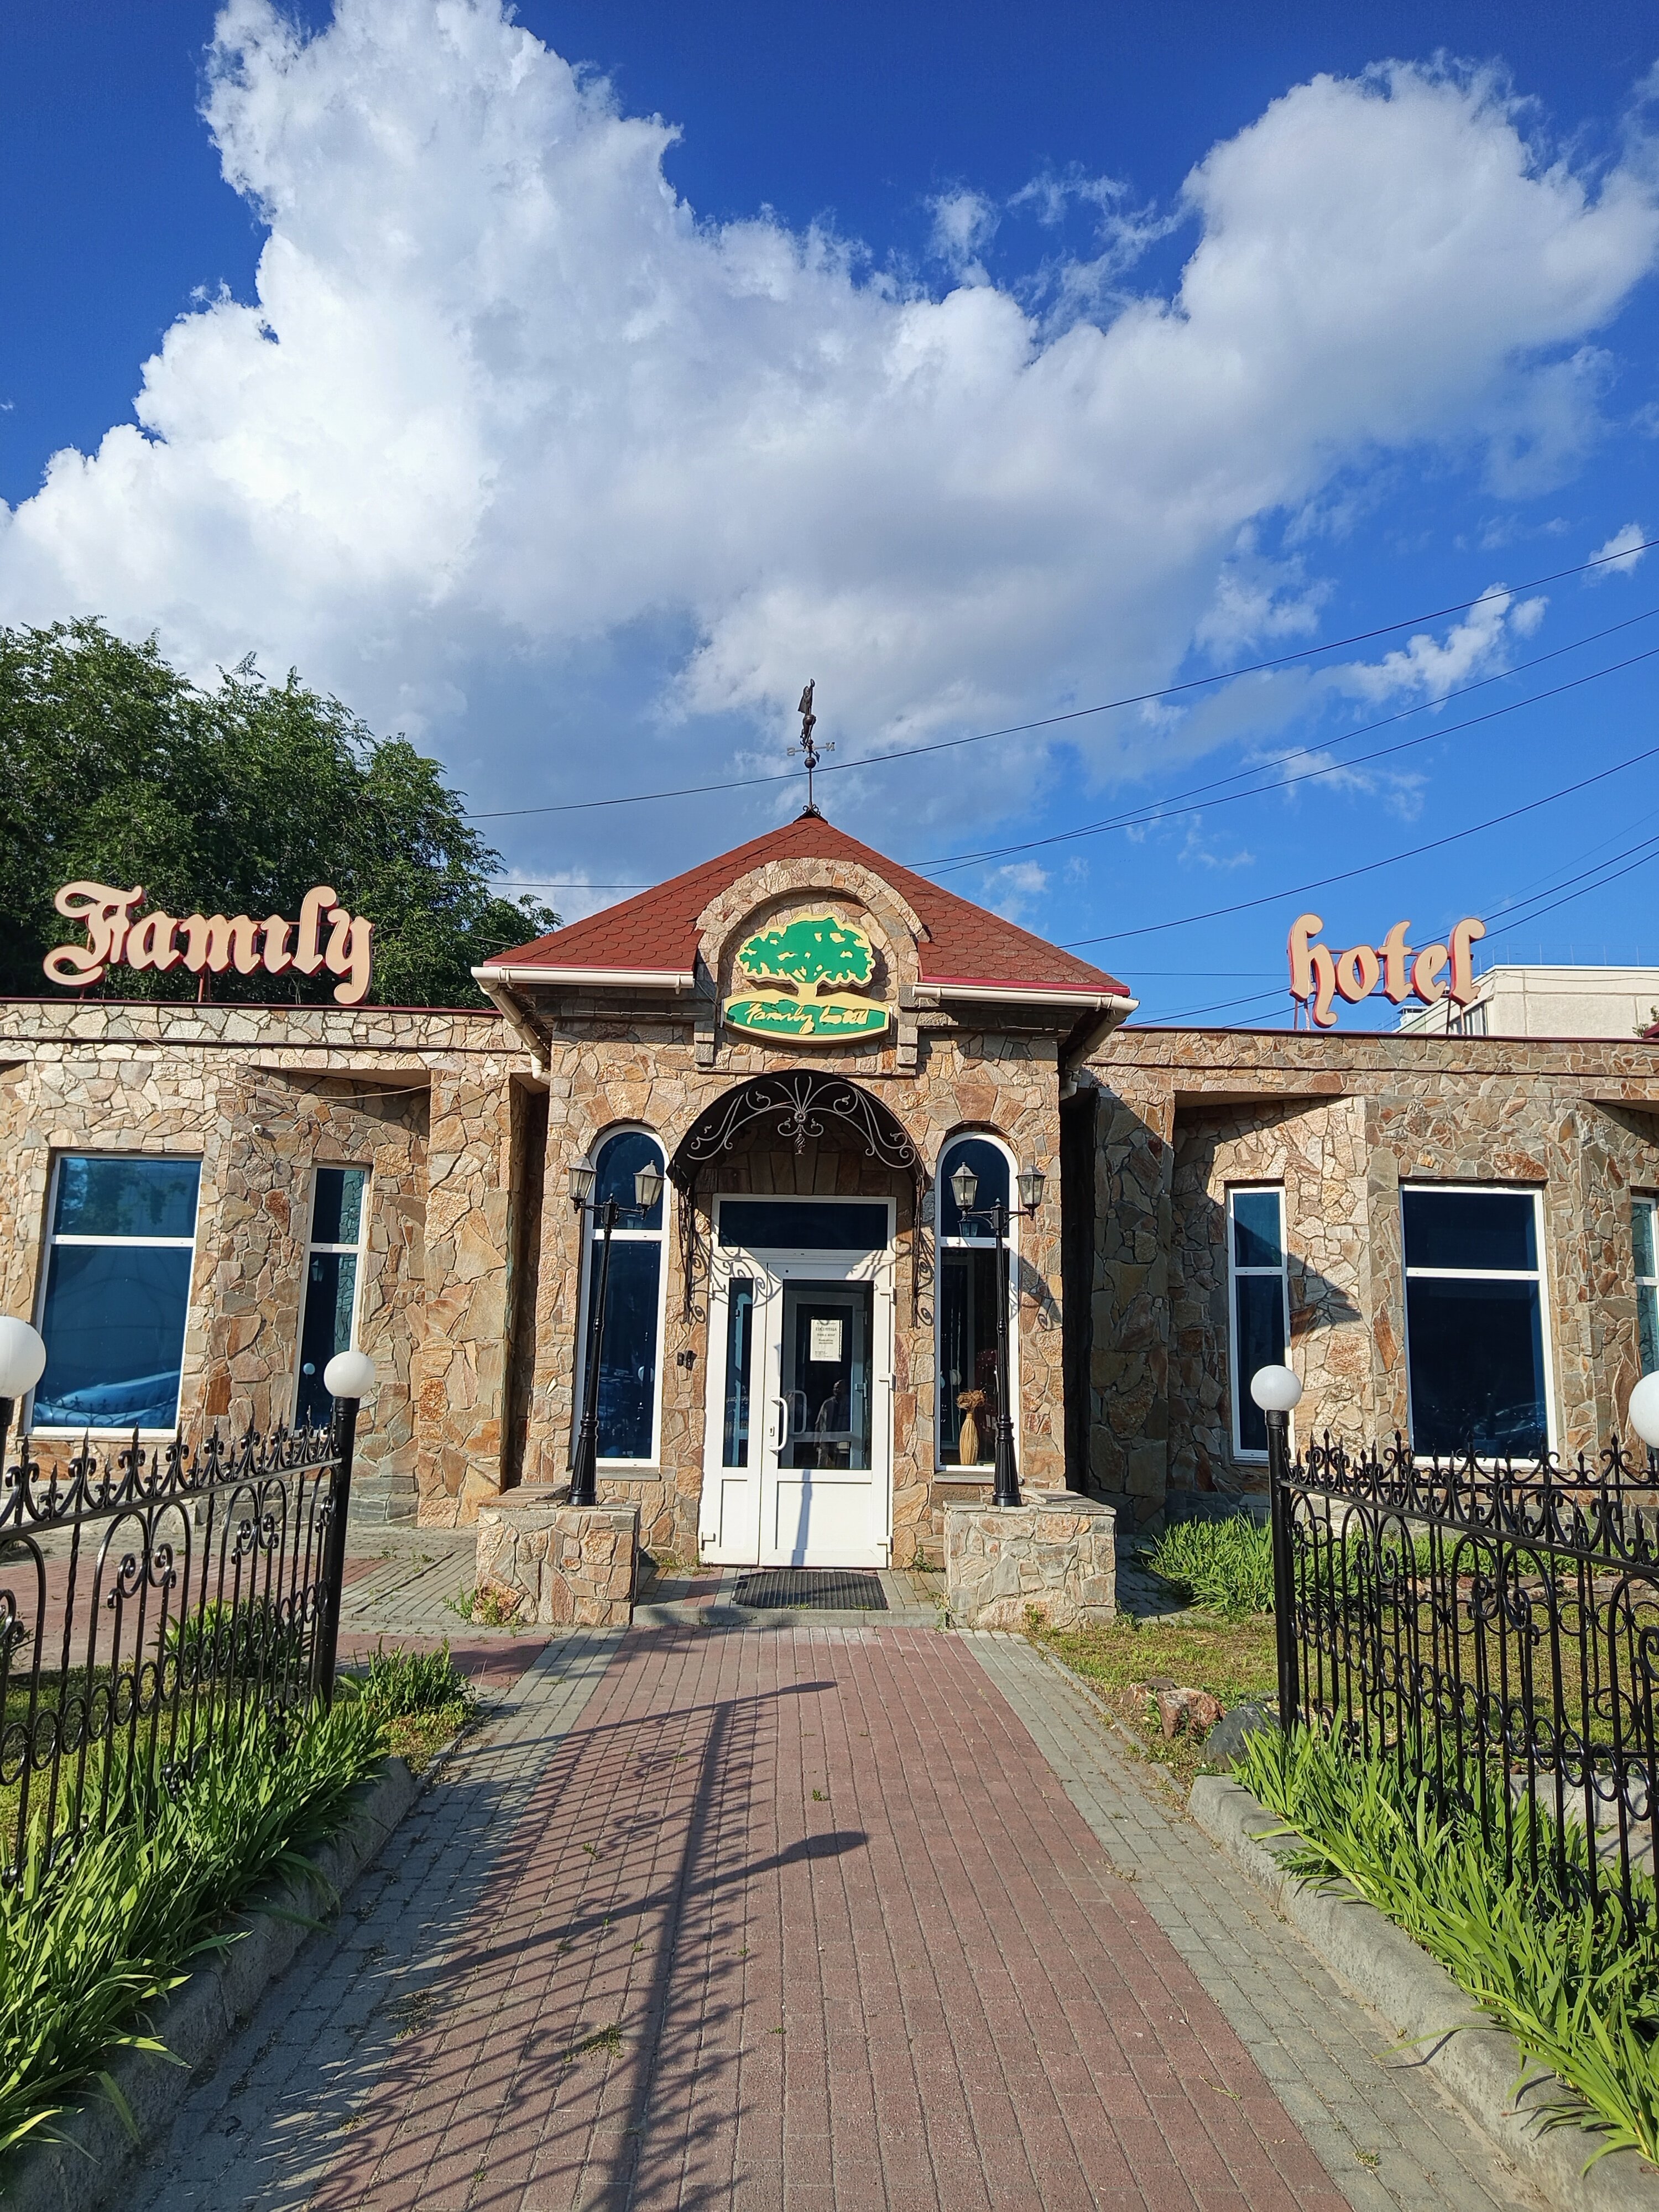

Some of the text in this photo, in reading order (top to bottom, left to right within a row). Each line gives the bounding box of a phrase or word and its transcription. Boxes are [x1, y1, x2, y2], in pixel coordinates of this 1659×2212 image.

[43, 880, 374, 1005] Family
[1287, 912, 1486, 1028] hotel
[744, 1001, 816, 1035] Family
